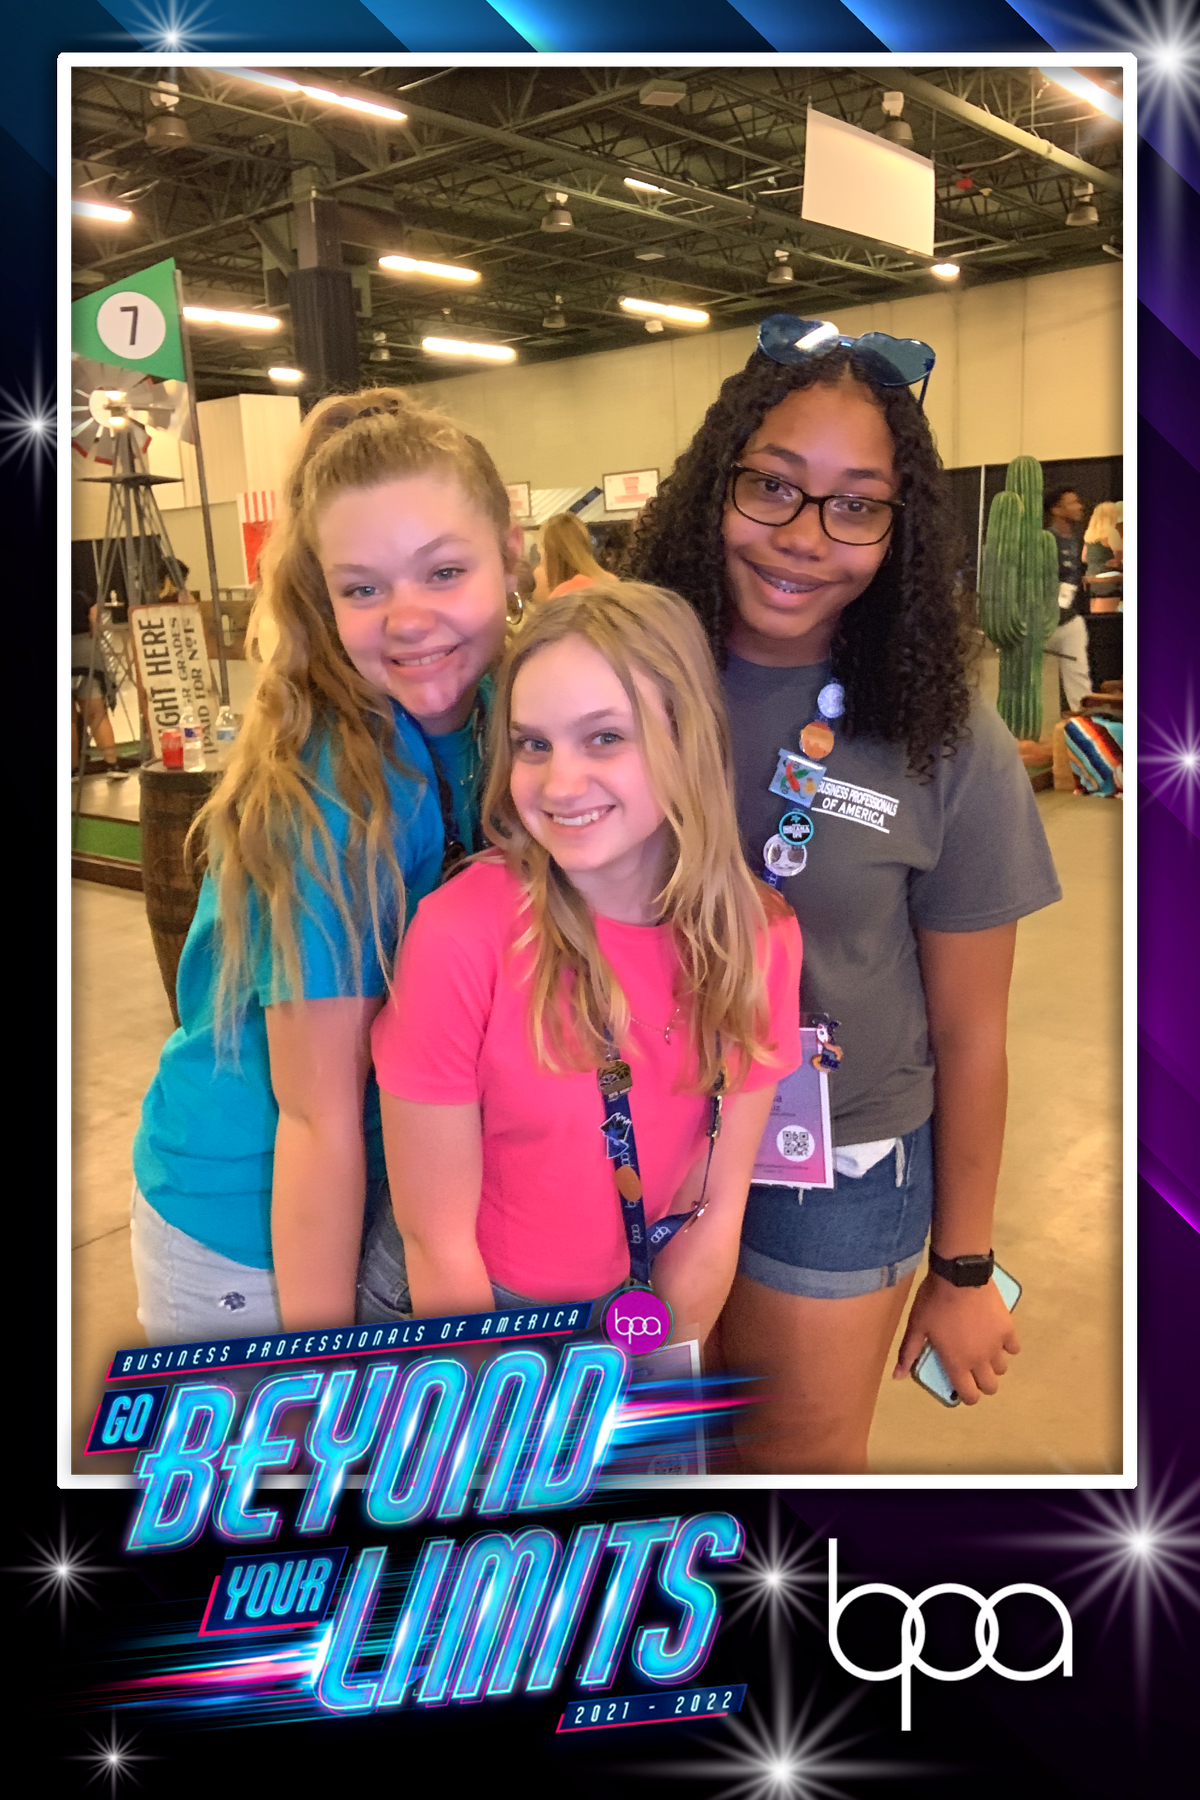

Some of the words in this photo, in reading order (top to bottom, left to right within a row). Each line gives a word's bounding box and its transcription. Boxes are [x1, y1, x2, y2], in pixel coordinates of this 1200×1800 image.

[120, 305, 139, 346] 7
[138, 617, 173, 677] HERE
[169, 617, 189, 681] GRADES
[191, 667, 206, 700] FOR
[821, 797, 838, 810] OF
[837, 801, 885, 827] AMERICA
[848, 789, 898, 817] PROFESSIONALS
